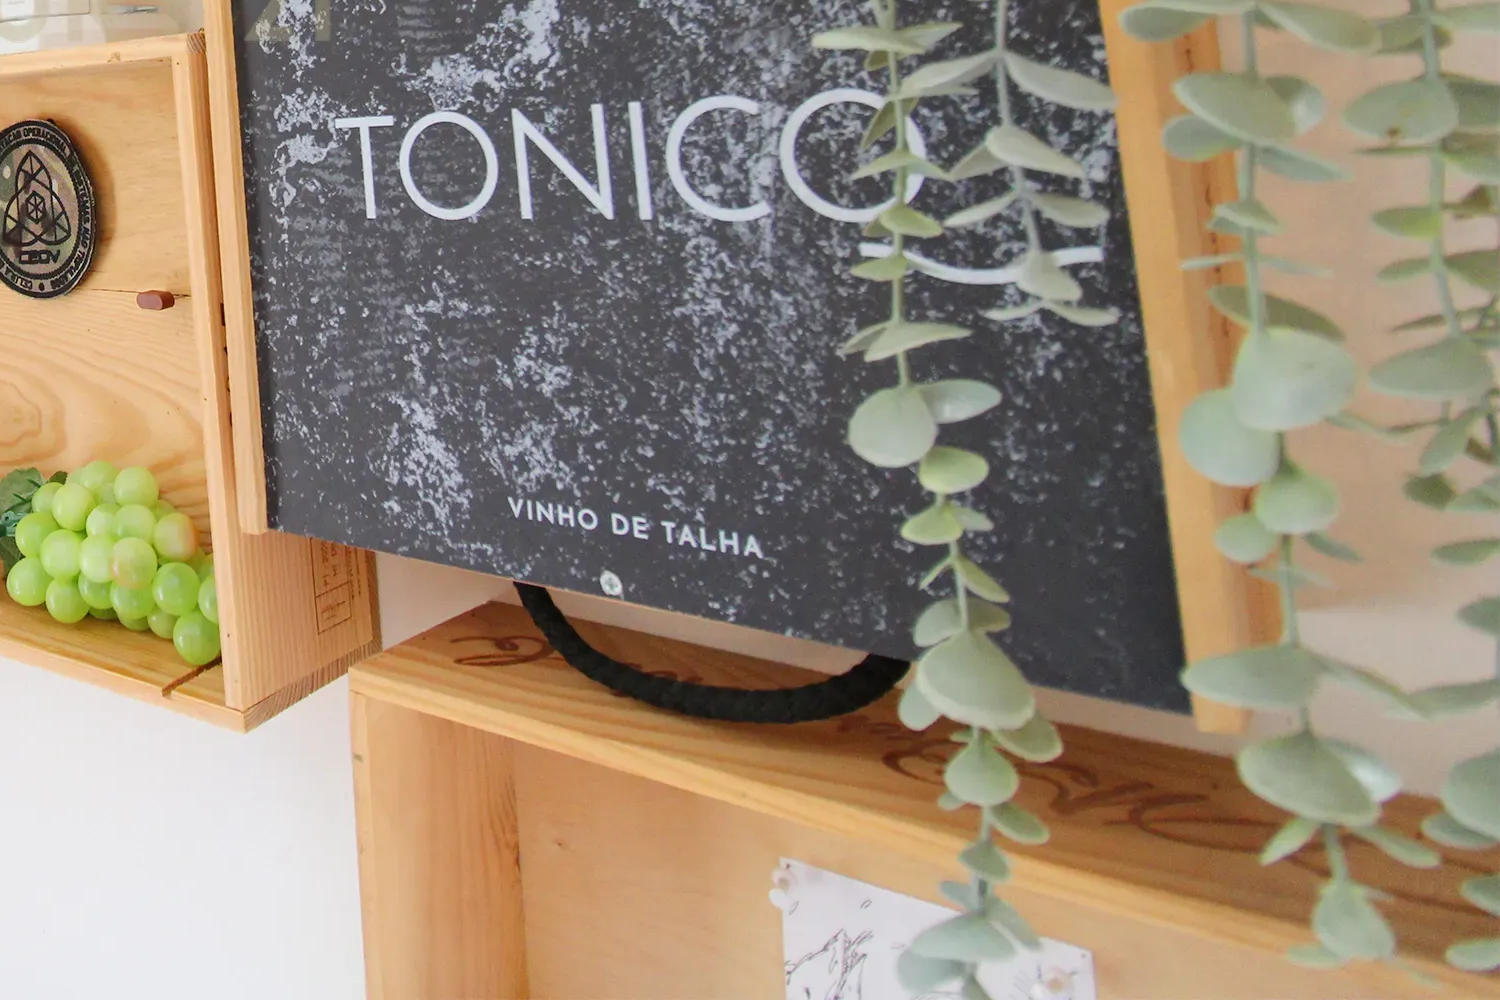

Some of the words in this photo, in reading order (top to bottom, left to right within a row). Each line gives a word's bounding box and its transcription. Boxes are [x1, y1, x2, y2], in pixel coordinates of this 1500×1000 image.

[335, 88, 927, 222] TONICO
[507, 496, 598, 531] VINHO
[611, 512, 649, 540] DE
[660, 520, 764, 560] TALHA
